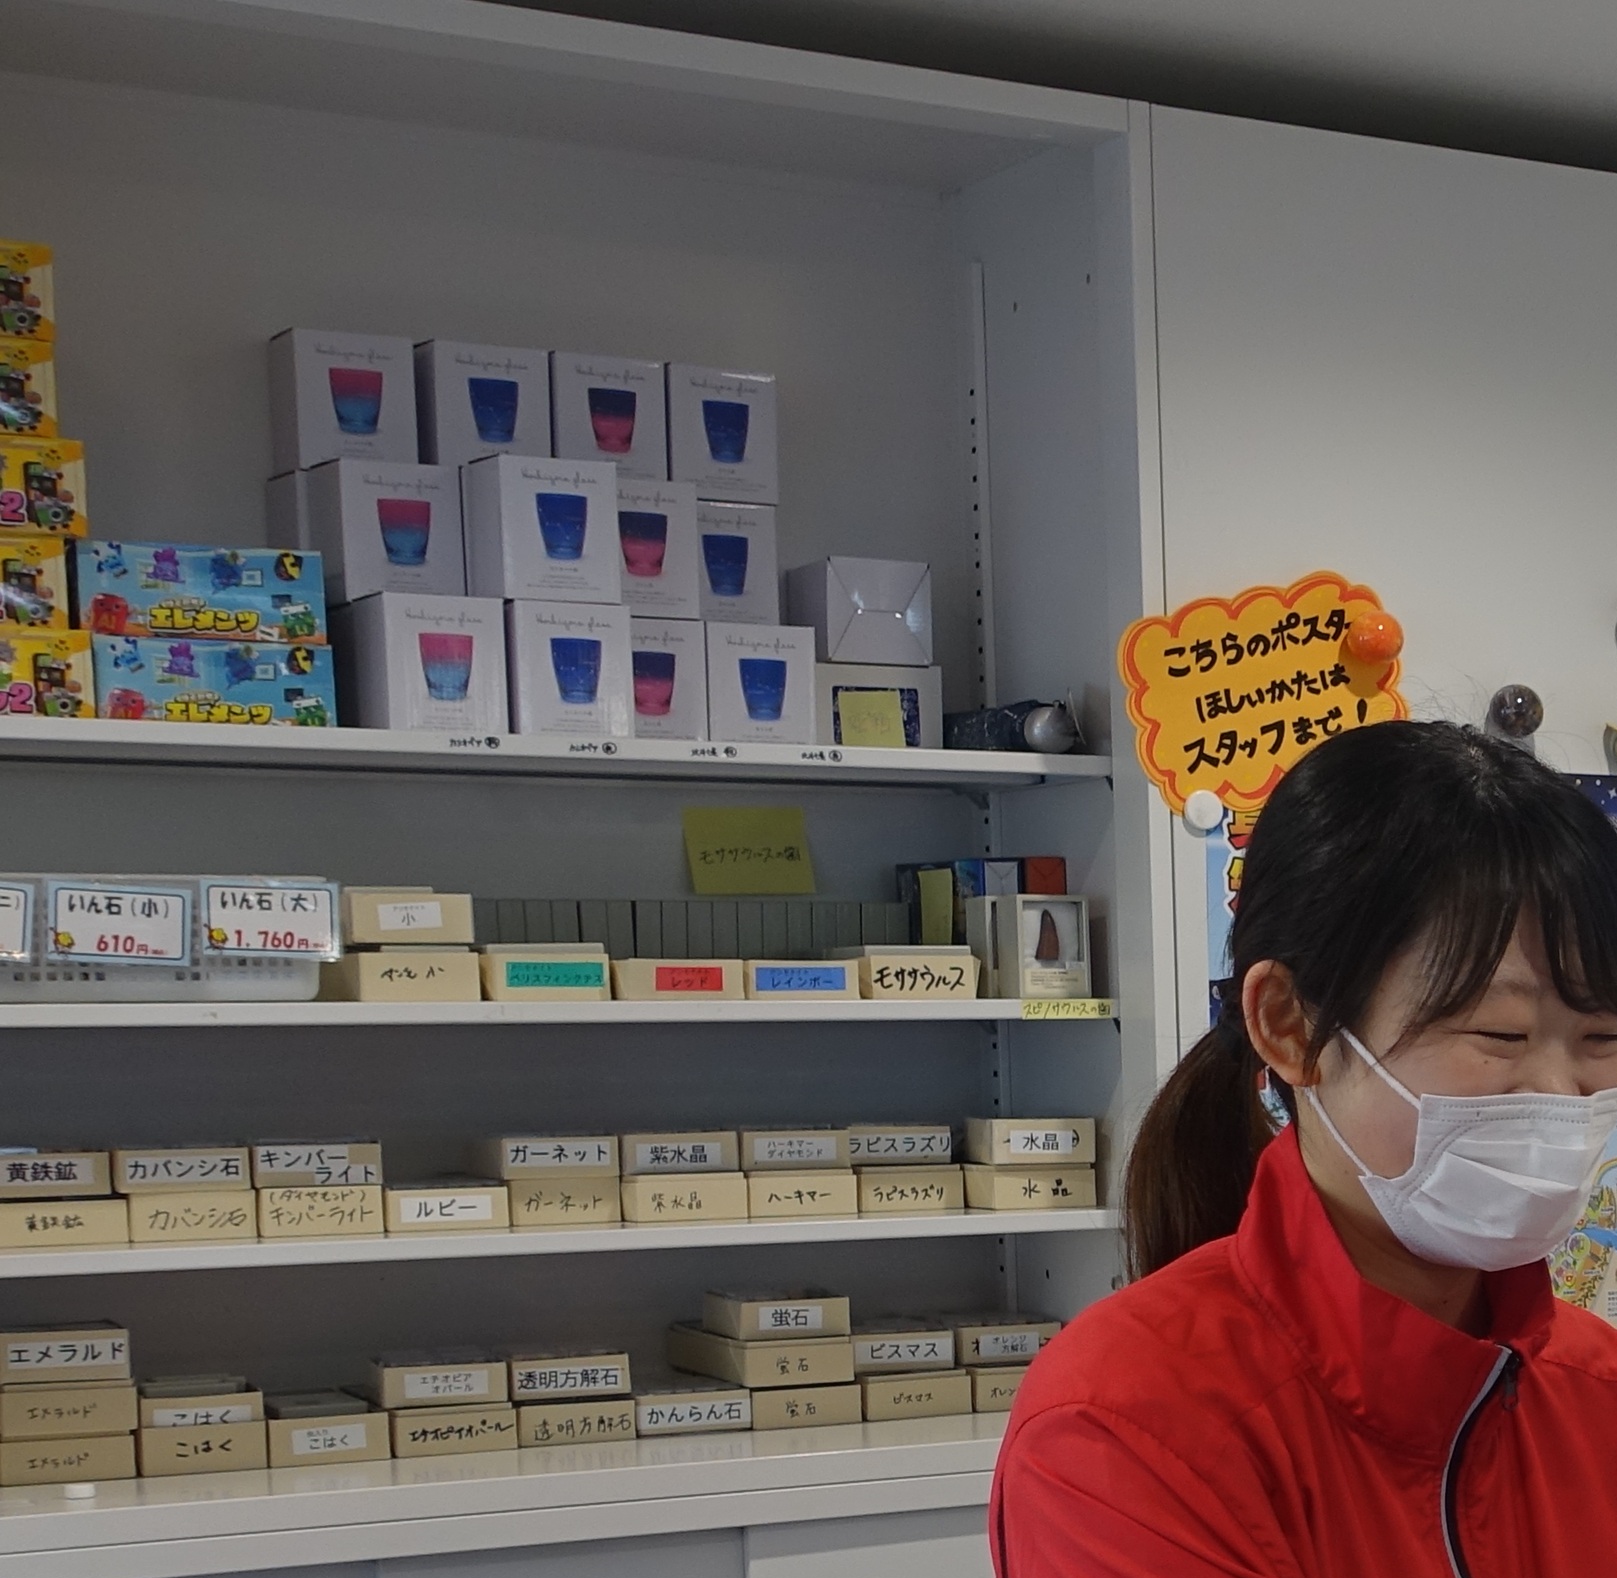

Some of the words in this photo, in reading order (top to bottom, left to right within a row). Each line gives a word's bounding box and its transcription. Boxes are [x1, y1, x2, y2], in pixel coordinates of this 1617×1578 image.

[149, 606, 260, 632] エレメンツ
[1195, 662, 1351, 723] ほしいかたは
[164, 700, 273, 724] エレメンツ
[67, 893, 170, 919] いん石(小)
[219, 890, 319, 913] いん石(大)
[400, 911, 416, 926] 小
[96, 933, 149, 955] 610円
[671, 976, 709, 988] レッド
[771, 976, 834, 989] レインボー
[872, 963, 966, 992] モササウルス
[767, 1140, 814, 1149] ハーキマー
[850, 1135, 951, 1154] ラピスラズリ
[1021, 1132, 1060, 1152] 水晶
[259, 1149, 348, 1169] キンバー
[509, 1144, 609, 1164] ガーネット
[648, 1145, 708, 1165] 紫水晶
[767, 1149, 824, 1158] ダイヤモンド
[6, 1160, 78, 1183] 黄鉄鉱
[127, 1157, 241, 1180] カバンシ石
[314, 1165, 376, 1185] ライト
[415, 1199, 478, 1219] ルビー
[524, 1191, 604, 1213] ガーネット
[148, 1207, 248, 1231] カバンシ石
[268, 1205, 375, 1227] キンバーライト
[9, 1341, 125, 1363] エメラルド
[869, 1341, 939, 1359] ビスマス
[420, 1373, 473, 1385] エチオピア
[517, 1368, 620, 1391] 透明方解石
[647, 1401, 742, 1426] かんらん石
[534, 1412, 632, 1442] 透明方解石
[174, 1438, 233, 1458] こはく
[309, 1434, 349, 1450] こはく
